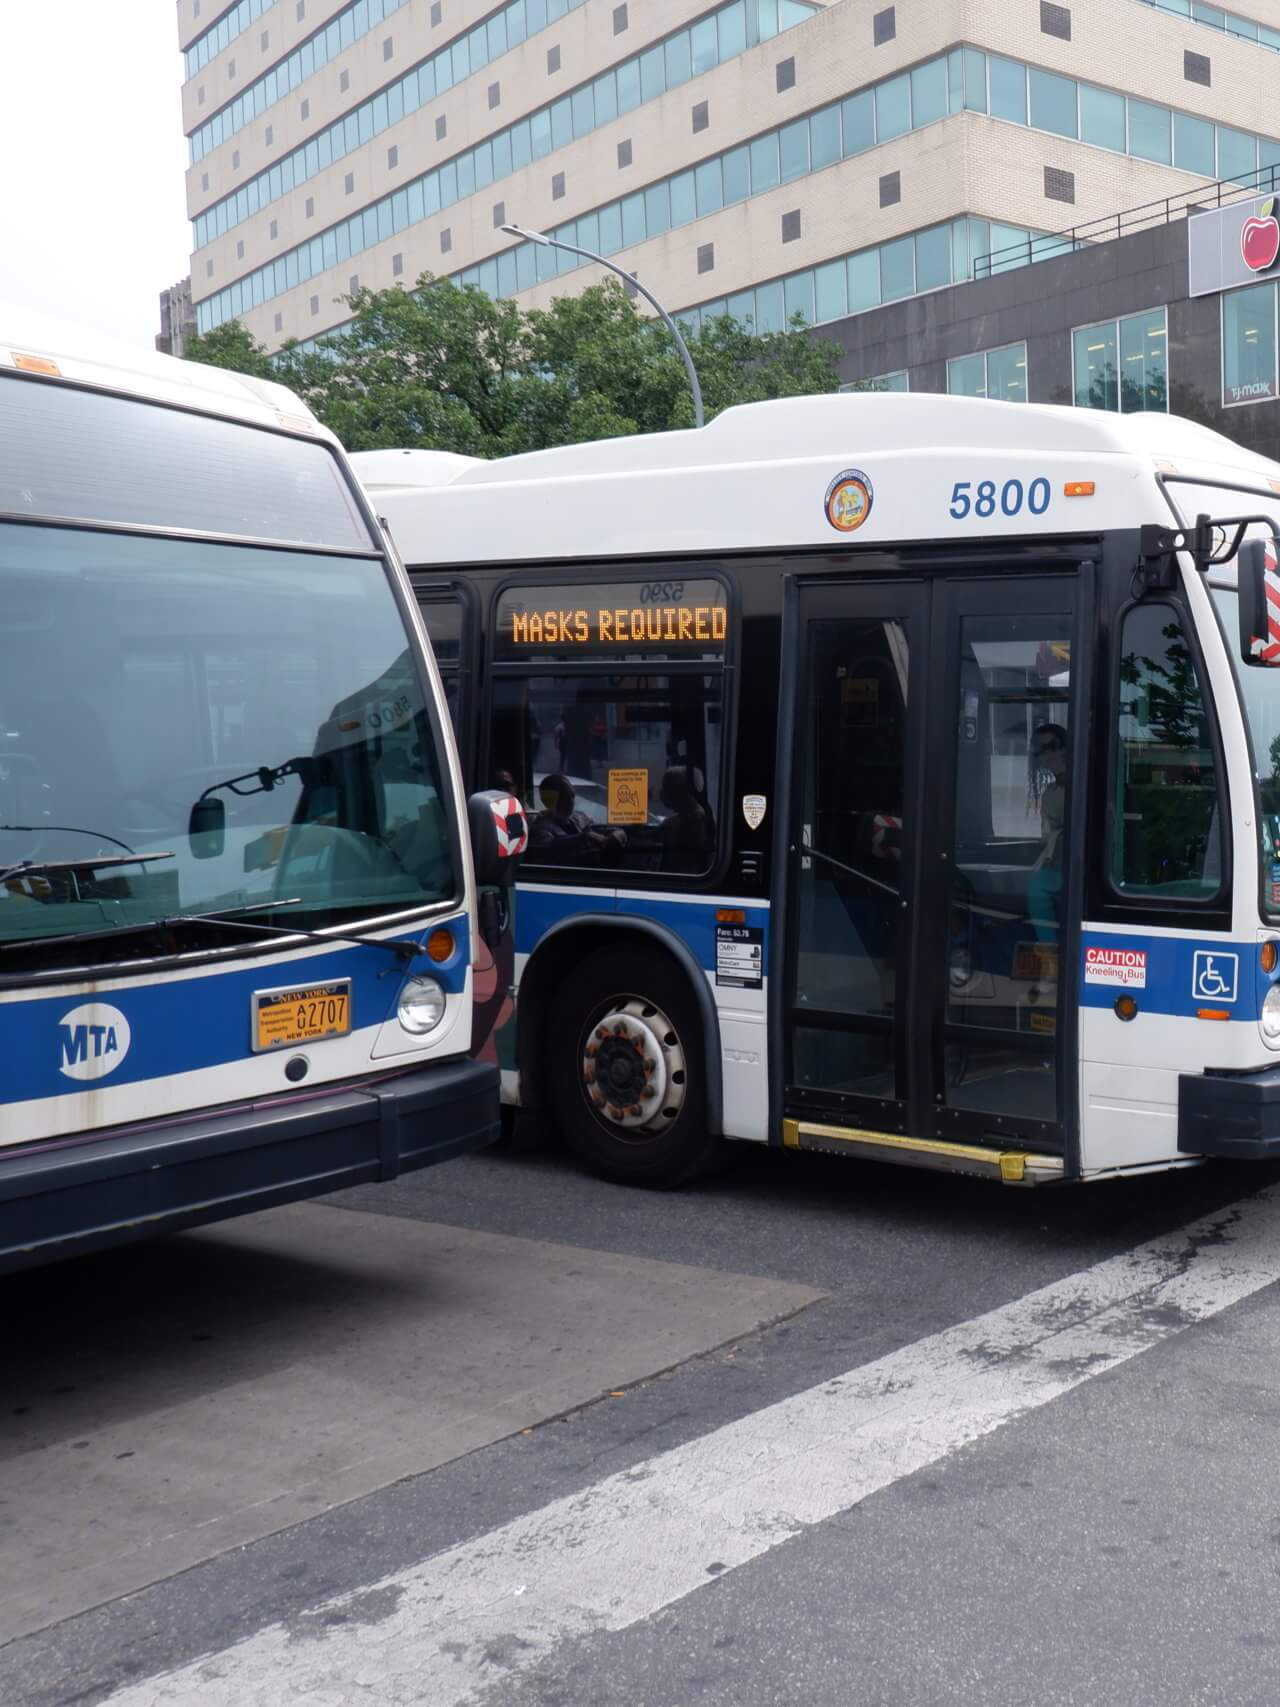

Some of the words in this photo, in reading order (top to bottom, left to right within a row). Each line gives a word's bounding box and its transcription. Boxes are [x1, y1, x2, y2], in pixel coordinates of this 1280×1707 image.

[950, 477, 1051, 520] 5800
[512, 611, 590, 642] MASKS
[599, 607, 727, 641] REQUIRED
[1087, 949, 1145, 966] CAUTION
[1086, 965, 1124, 979] Kneeling
[1127, 968, 1145, 980] Bus
[308, 998, 345, 1027] 2707
[57, 1024, 118, 1069] MTA
[286, 1032, 302, 1040] NEW
